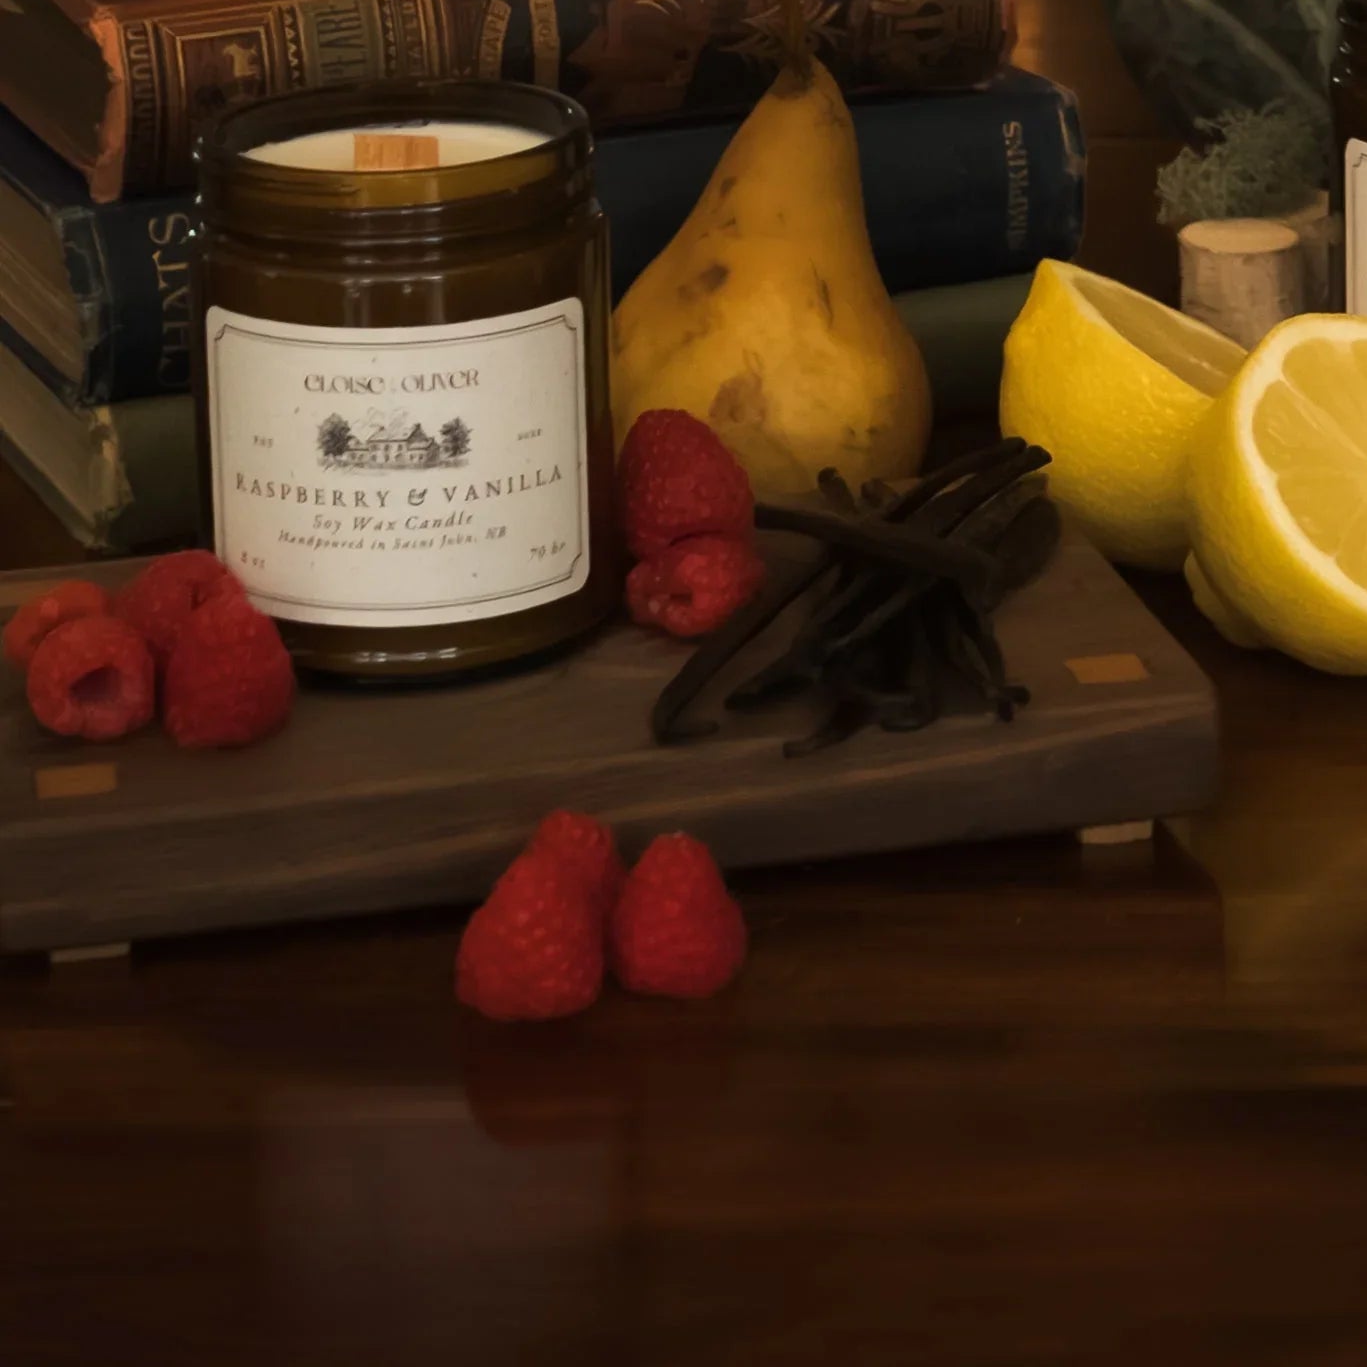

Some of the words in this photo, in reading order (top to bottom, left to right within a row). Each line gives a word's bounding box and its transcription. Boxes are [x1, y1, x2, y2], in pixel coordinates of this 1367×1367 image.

[401, 369, 480, 393] OLIVER
[236, 472, 390, 508] RASPBERRY
[408, 488, 428, 506] &
[443, 465, 563, 503] VANILLA
[313, 514, 342, 534] Soy
[353, 515, 397, 531] Wax
[404, 511, 474, 530] Candle
[278, 529, 364, 551] Handpoured
[370, 536, 385, 550] in
[392, 536, 435, 550] Saint
[485, 525, 507, 540] NB
